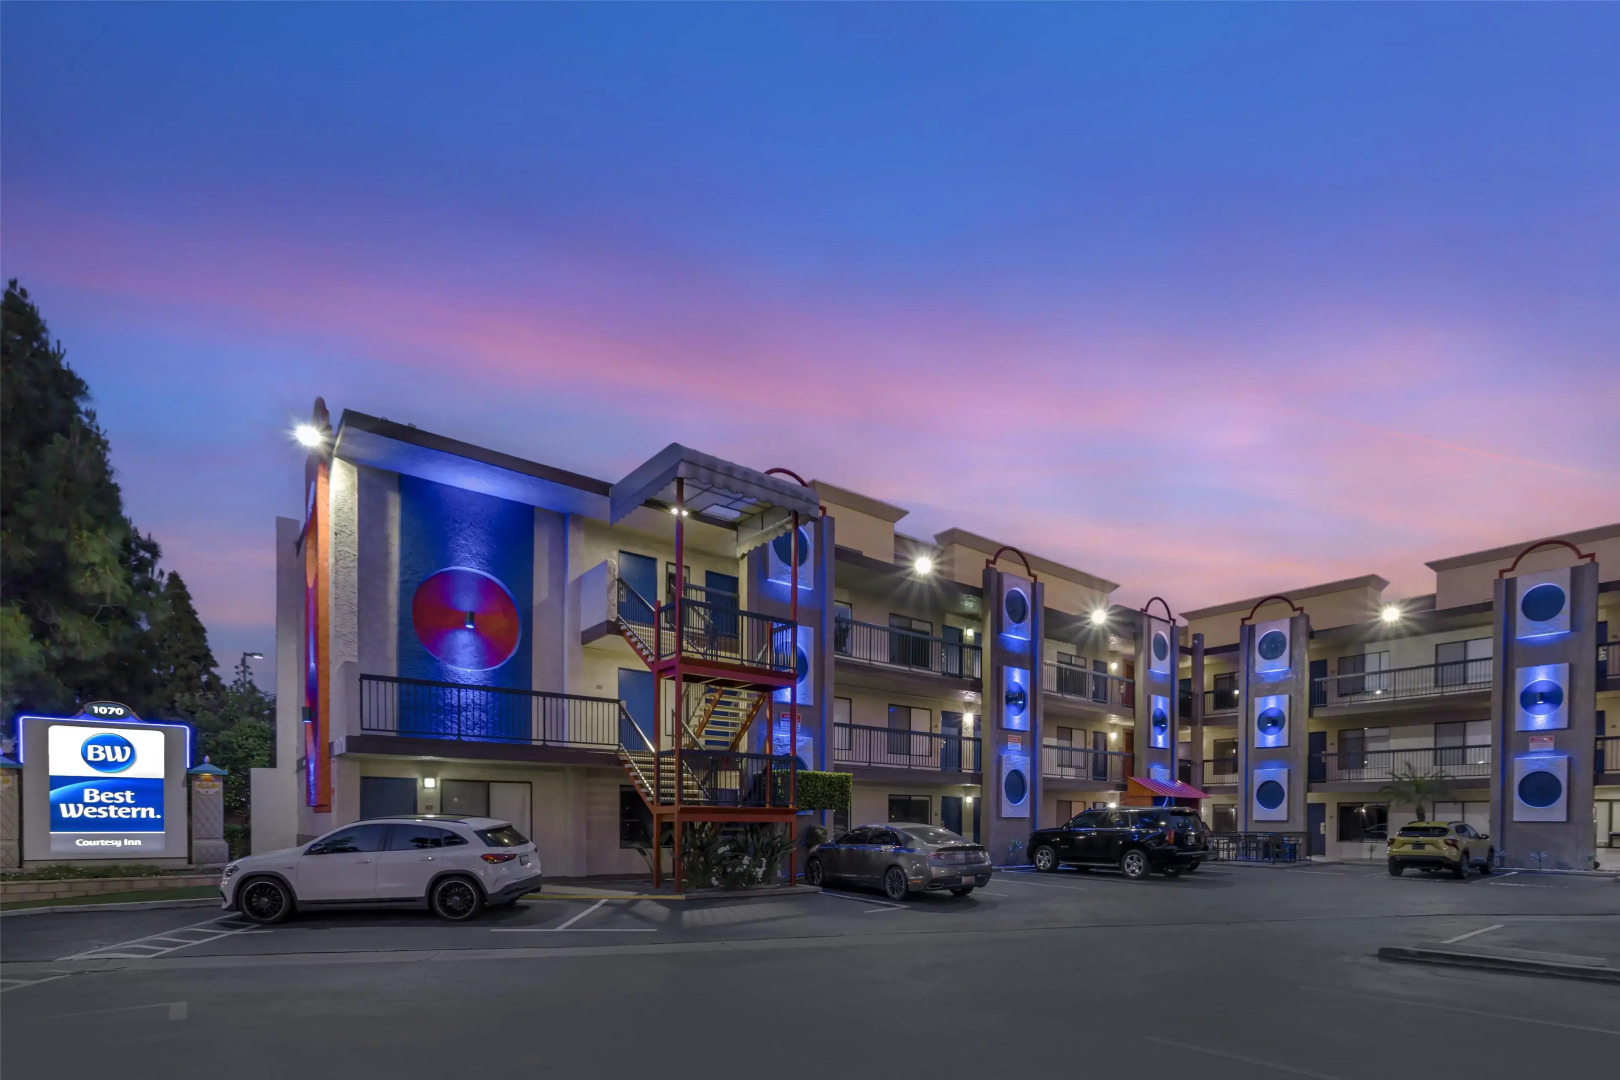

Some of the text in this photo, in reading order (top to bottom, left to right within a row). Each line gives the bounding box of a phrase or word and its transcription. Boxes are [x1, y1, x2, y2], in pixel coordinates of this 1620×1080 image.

[92, 706, 125, 716] 1070
[87, 744, 131, 763] BW
[83, 788, 136, 804] Best
[75, 838, 142, 848] Courtesy Inn
